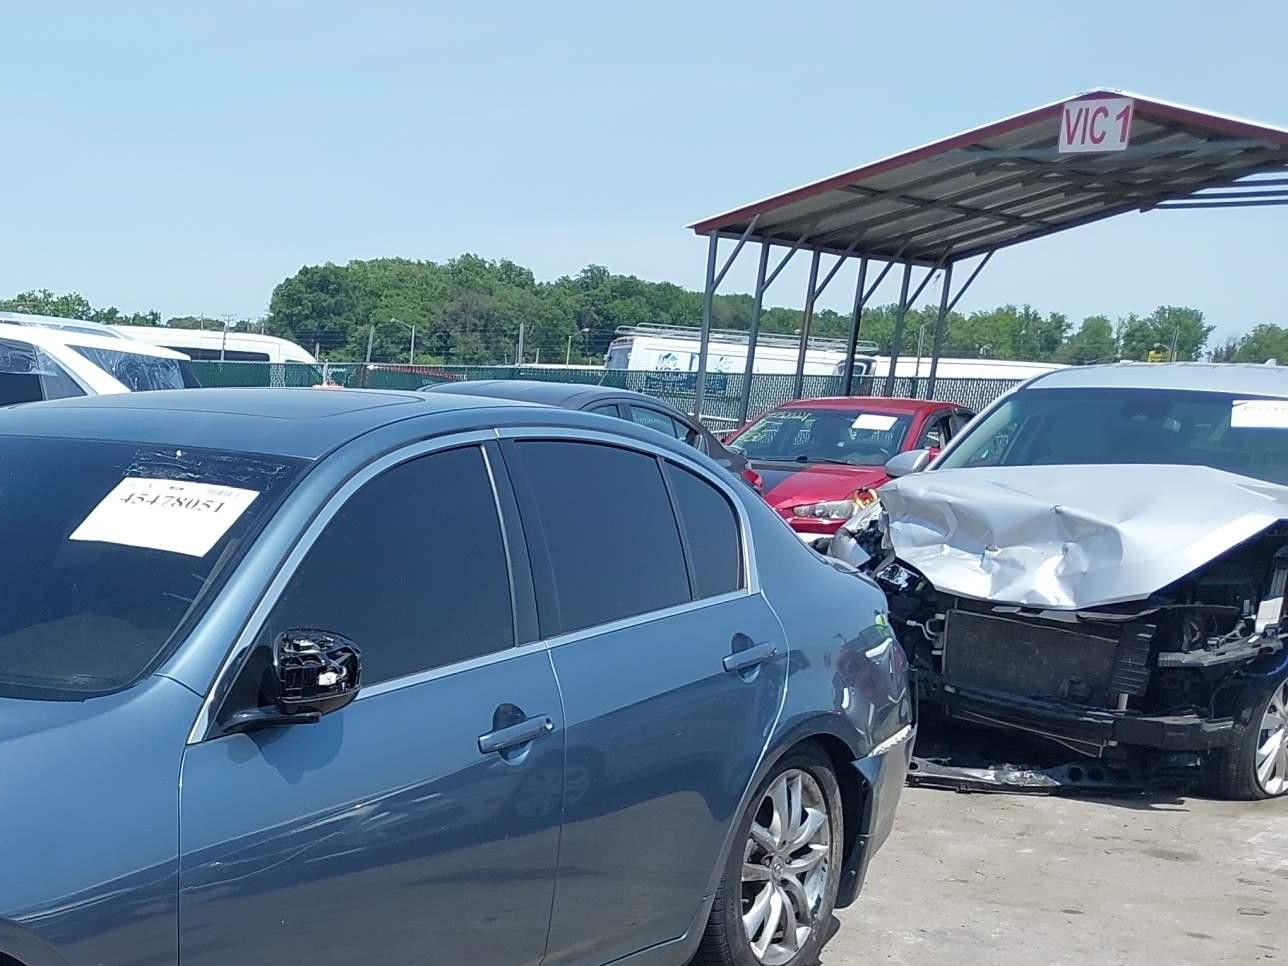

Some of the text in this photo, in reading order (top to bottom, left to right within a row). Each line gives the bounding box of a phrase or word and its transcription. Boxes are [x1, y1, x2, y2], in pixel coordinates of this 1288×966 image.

[1065, 104, 1131, 145] VIC 1
[120, 492, 225, 513] 45478051
